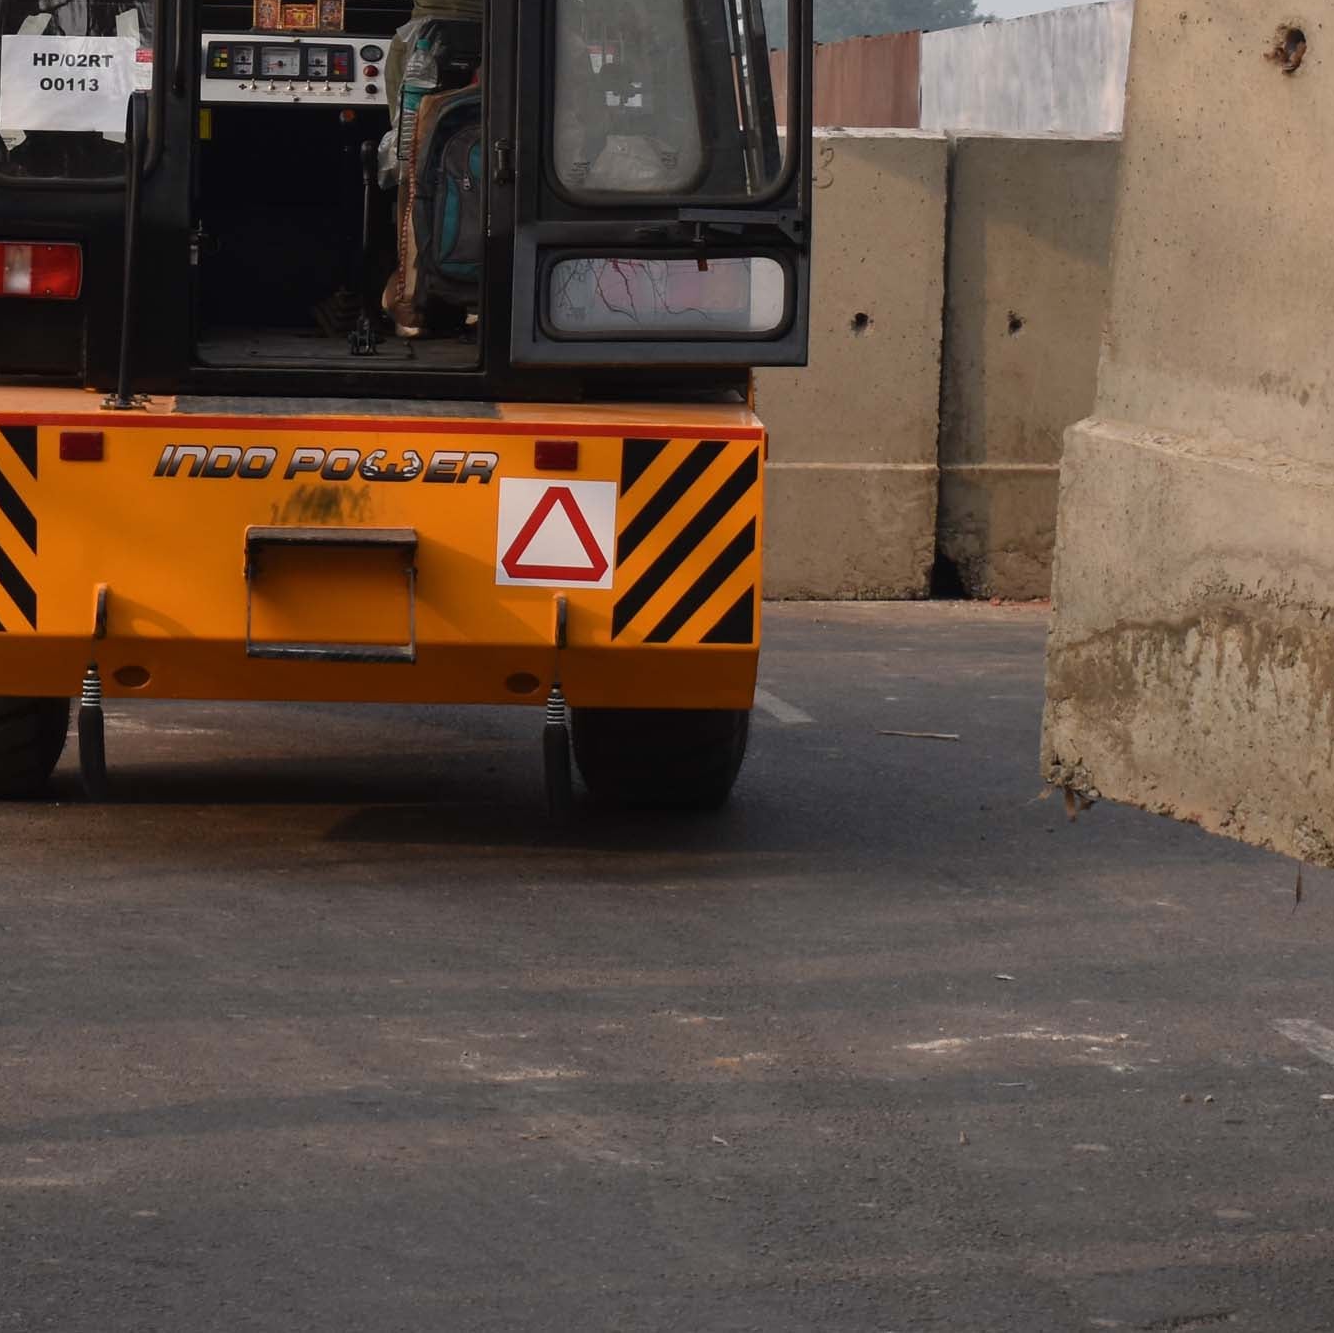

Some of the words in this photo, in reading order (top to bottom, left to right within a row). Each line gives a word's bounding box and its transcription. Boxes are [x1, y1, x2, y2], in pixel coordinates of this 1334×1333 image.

[32, 52, 114, 68] HP/02RT
[154, 444, 278, 479] INDO
[283, 447, 500, 484] POWER
